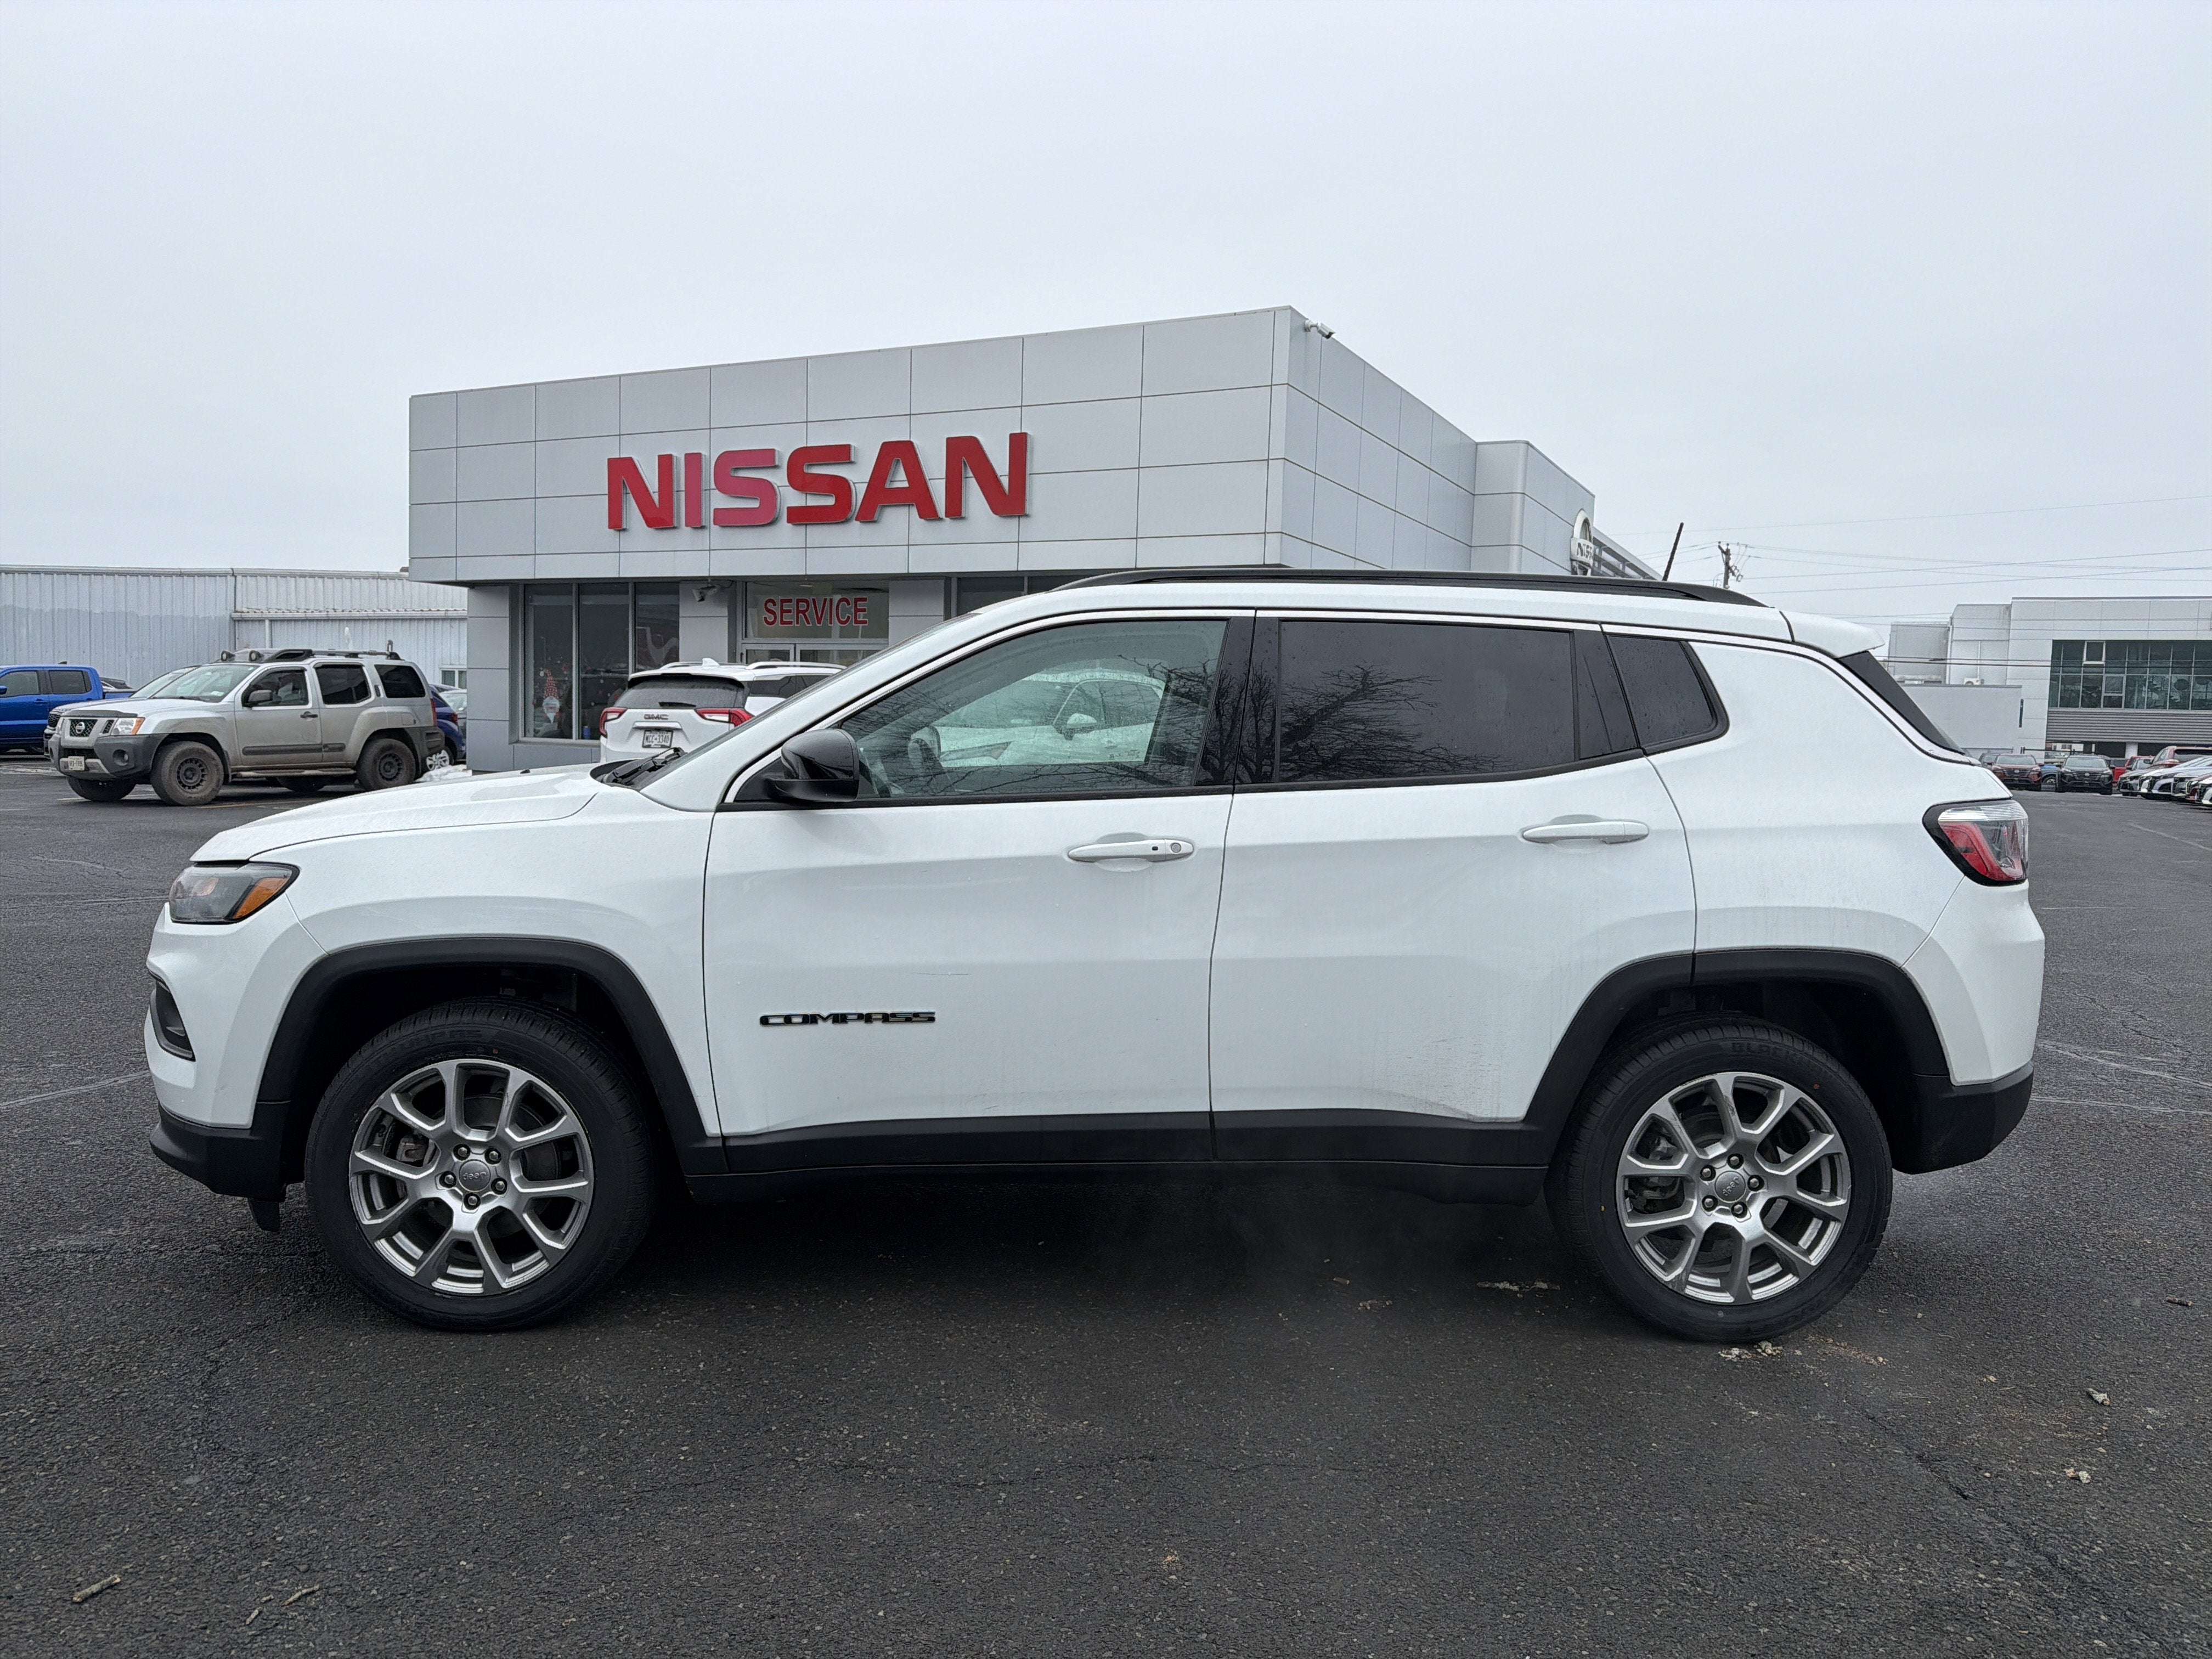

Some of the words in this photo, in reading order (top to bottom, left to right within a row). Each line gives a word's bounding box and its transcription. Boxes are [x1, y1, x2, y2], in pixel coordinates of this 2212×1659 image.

[607, 432, 1031, 531] NISSAN
[1576, 542, 1593, 560] NISS
[763, 597, 868, 627] SERVICE
[760, 1012, 935, 1026] COMPASS
[462, 1171, 487, 1180] Jeep
[1723, 1176, 1740, 1196] Jeep
